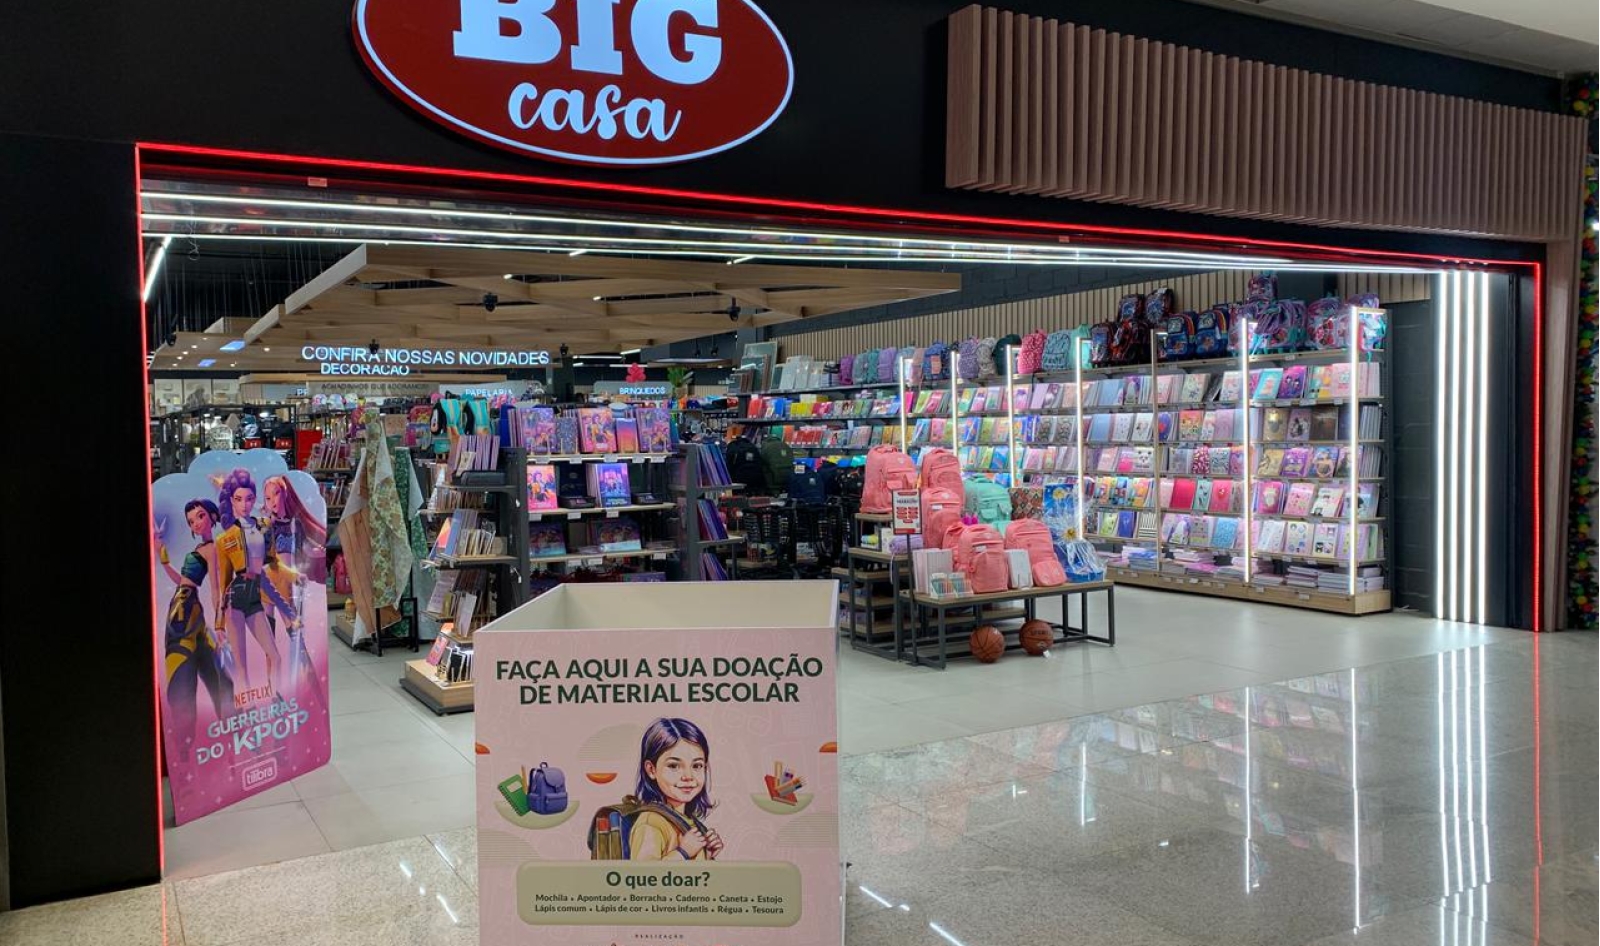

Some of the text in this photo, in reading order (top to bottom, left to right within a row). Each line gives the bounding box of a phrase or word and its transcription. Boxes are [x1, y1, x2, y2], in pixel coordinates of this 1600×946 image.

[453, 0, 722, 85] BIG
[508, 82, 682, 141] casa
[301, 345, 549, 365] CONFIRA NOSSAS NOVIDADES
[465, 388, 513, 396] PAPELARIA
[496, 653, 823, 683] FAÇA AQUI A SUA DOAÇÃO
[519, 682, 800, 705] DE MATERIAL ESCOLAR
[207, 698, 298, 738] GUERREIRAS
[196, 743, 224, 765] DO
[606, 871, 710, 890] O que doar?
[535, 904, 556, 913] Lápis
[596, 904, 617, 913] Lápis
[678, 905, 709, 913] infantis
[717, 905, 743, 914] Régua
[752, 906, 784, 914] Tesoura
[577, 894, 620, 903] Apontador
[630, 894, 667, 902] Borracha
[675, 894, 710, 902] Caderno
[757, 895, 783, 904] Estojo
